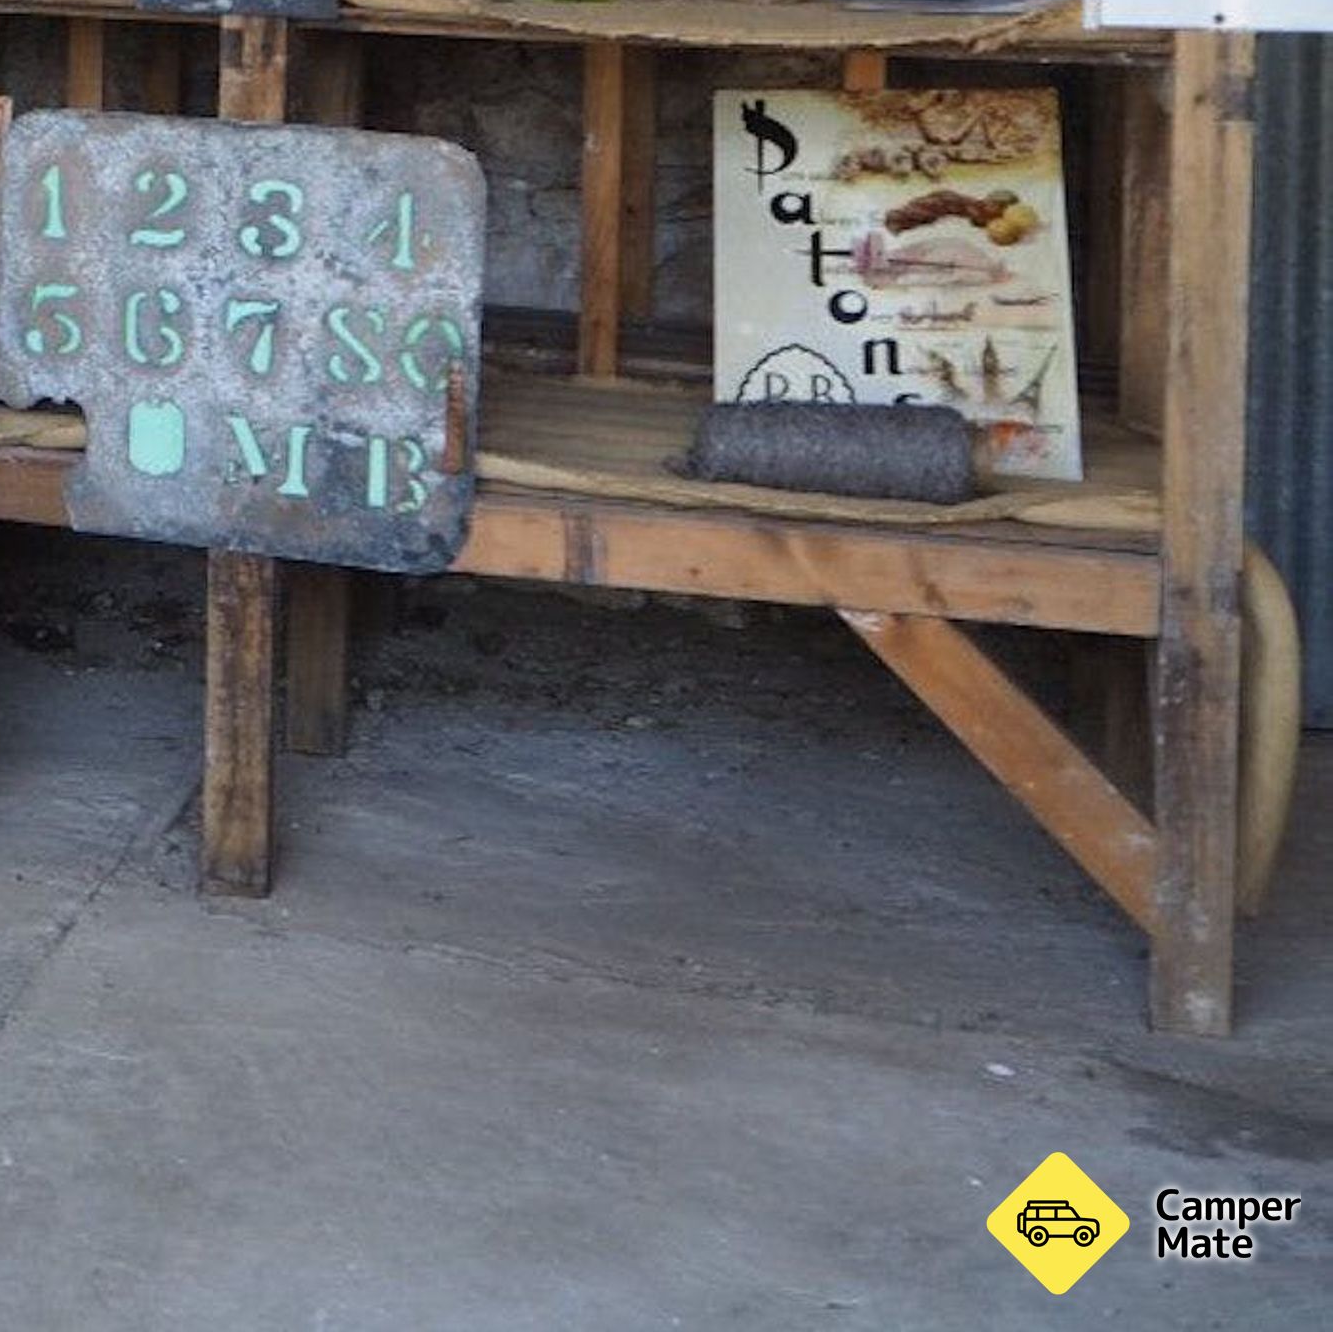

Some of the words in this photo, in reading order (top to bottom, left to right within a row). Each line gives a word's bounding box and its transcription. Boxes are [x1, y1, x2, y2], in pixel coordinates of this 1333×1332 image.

[40, 165, 67, 239] 1
[129, 170, 188, 248] 2
[239, 179, 304, 259] 3
[23, 284, 83, 355] 5
[124, 289, 185, 367] 6
[225, 299, 280, 375] 7
